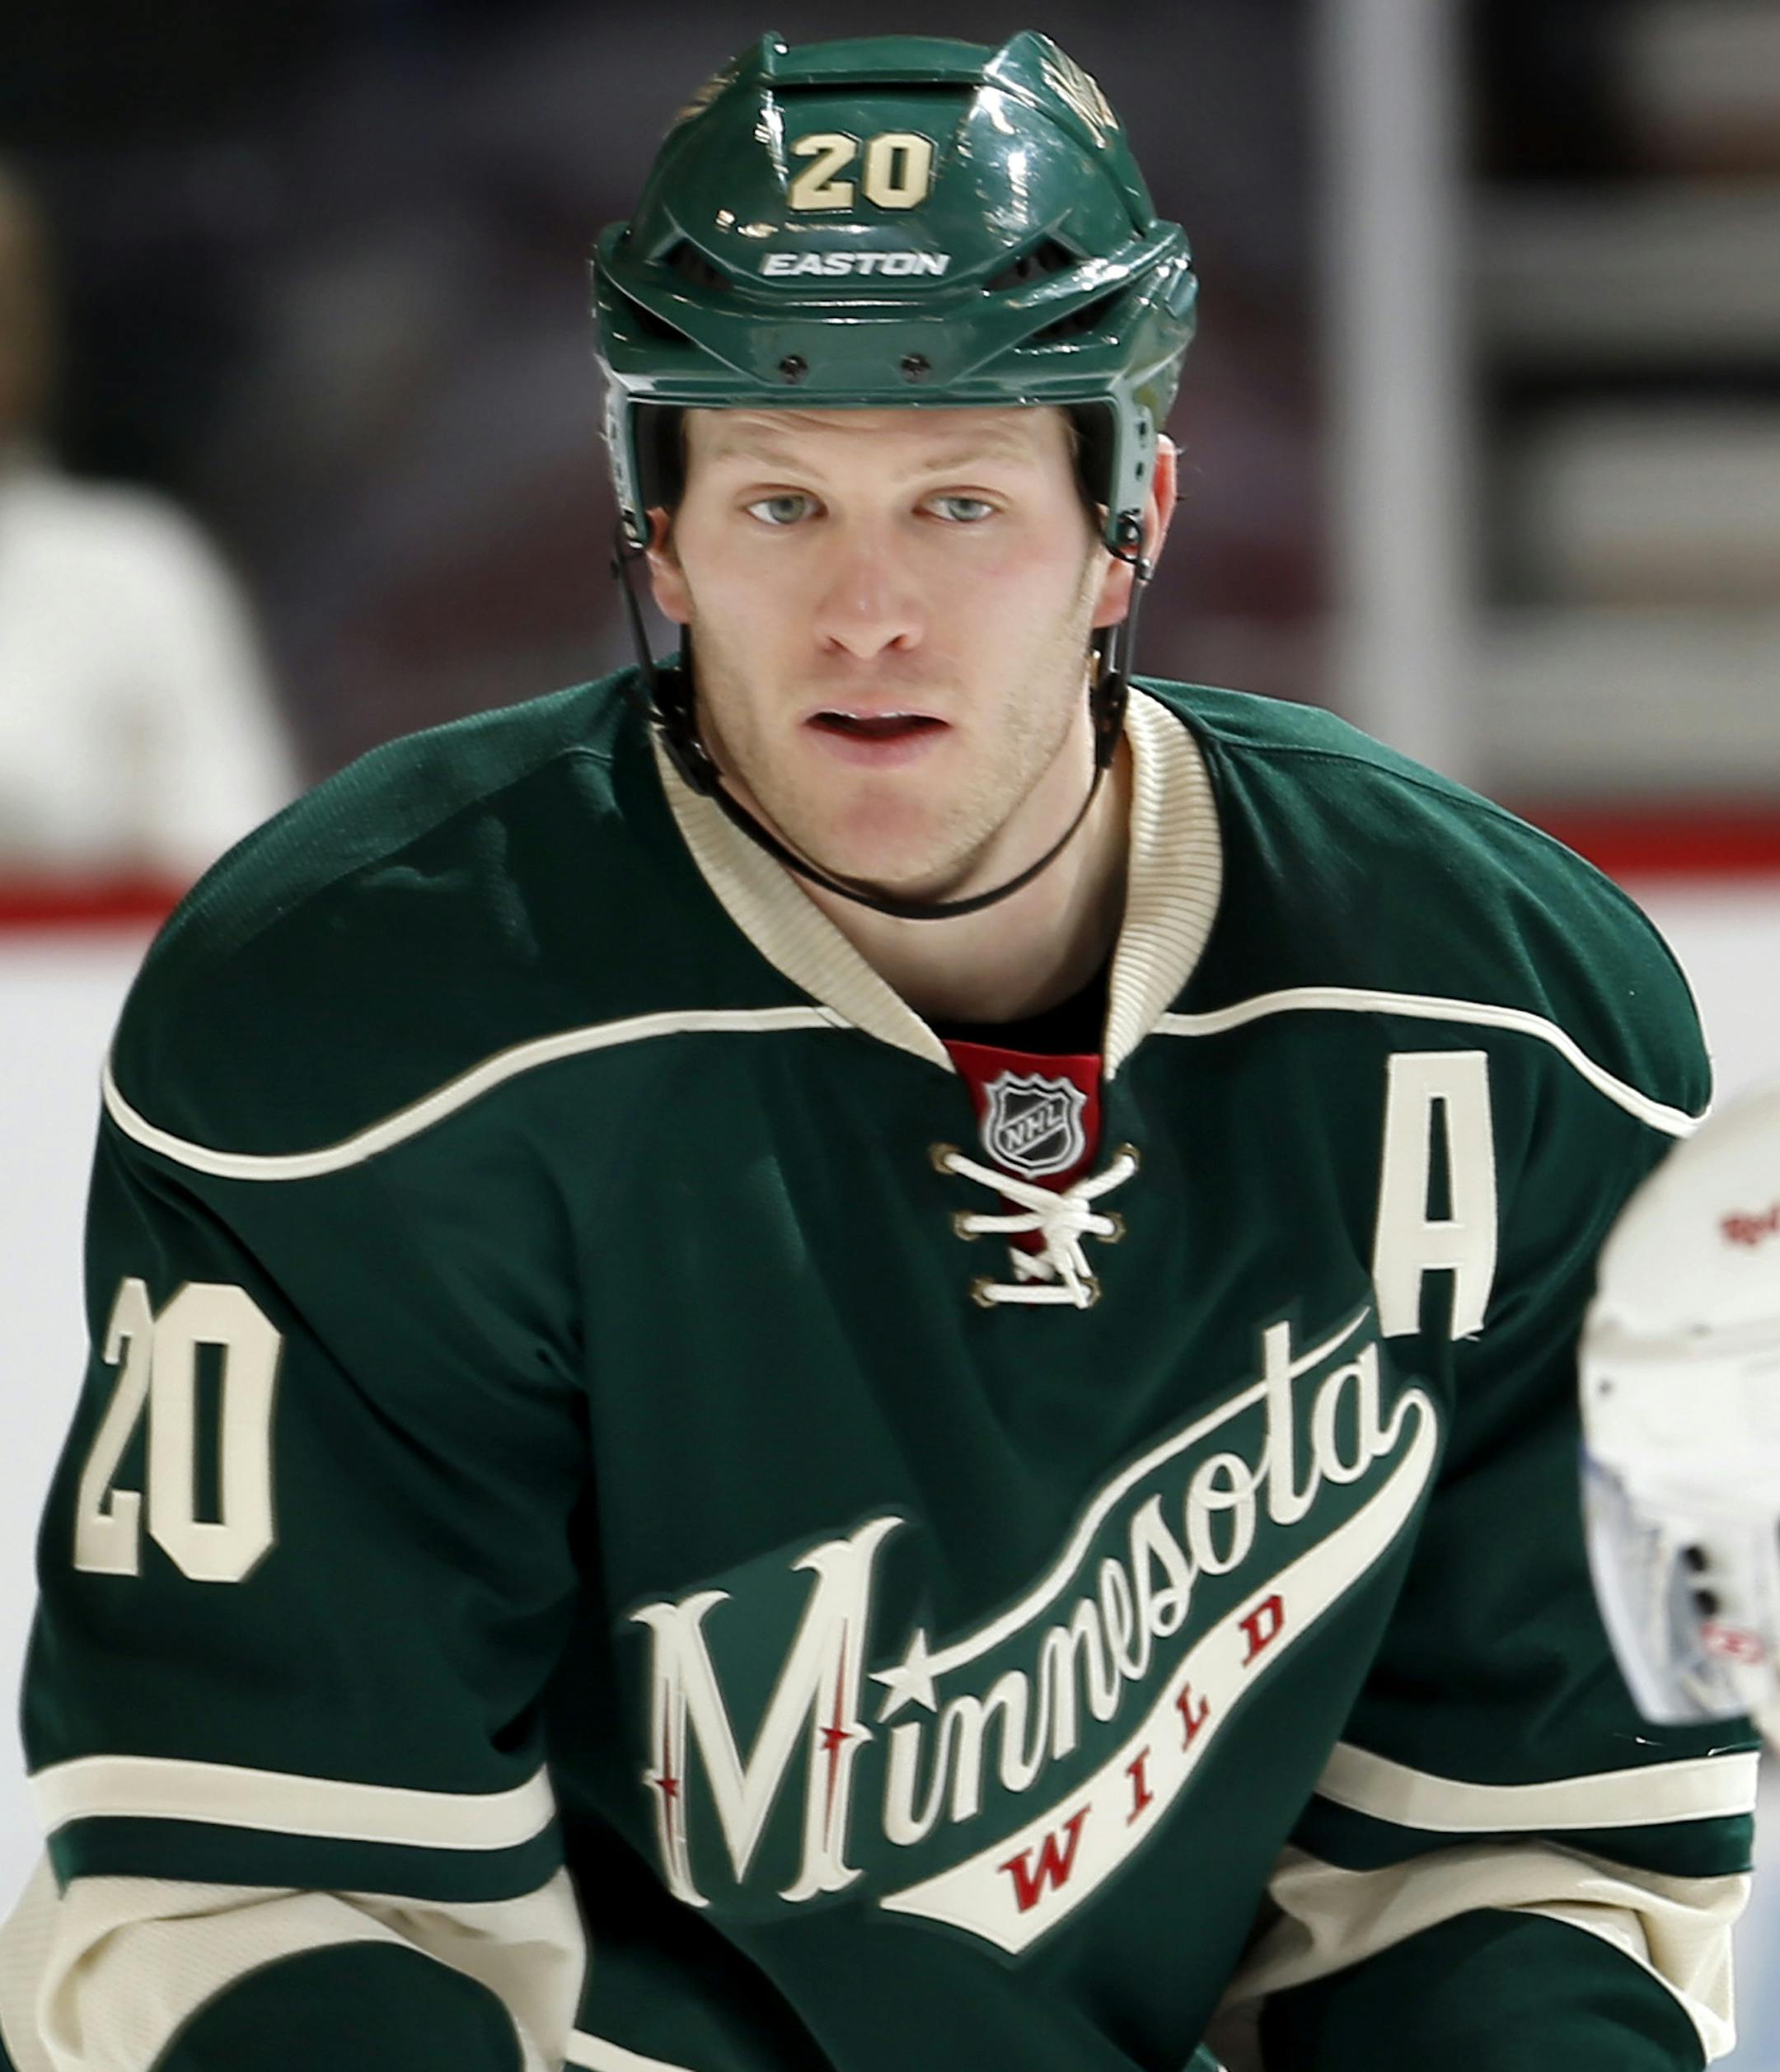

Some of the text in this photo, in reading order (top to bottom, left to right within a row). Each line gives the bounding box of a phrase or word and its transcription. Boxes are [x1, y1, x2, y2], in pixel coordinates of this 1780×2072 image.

[761, 251, 950, 276] EASTON
[790, 133, 932, 210] 20
[1006, 1104, 1064, 1150] NHL
[1372, 1050, 1498, 1341] A
[74, 1276, 283, 1583] 20
[630, 1312, 1413, 1908] Minnesota
